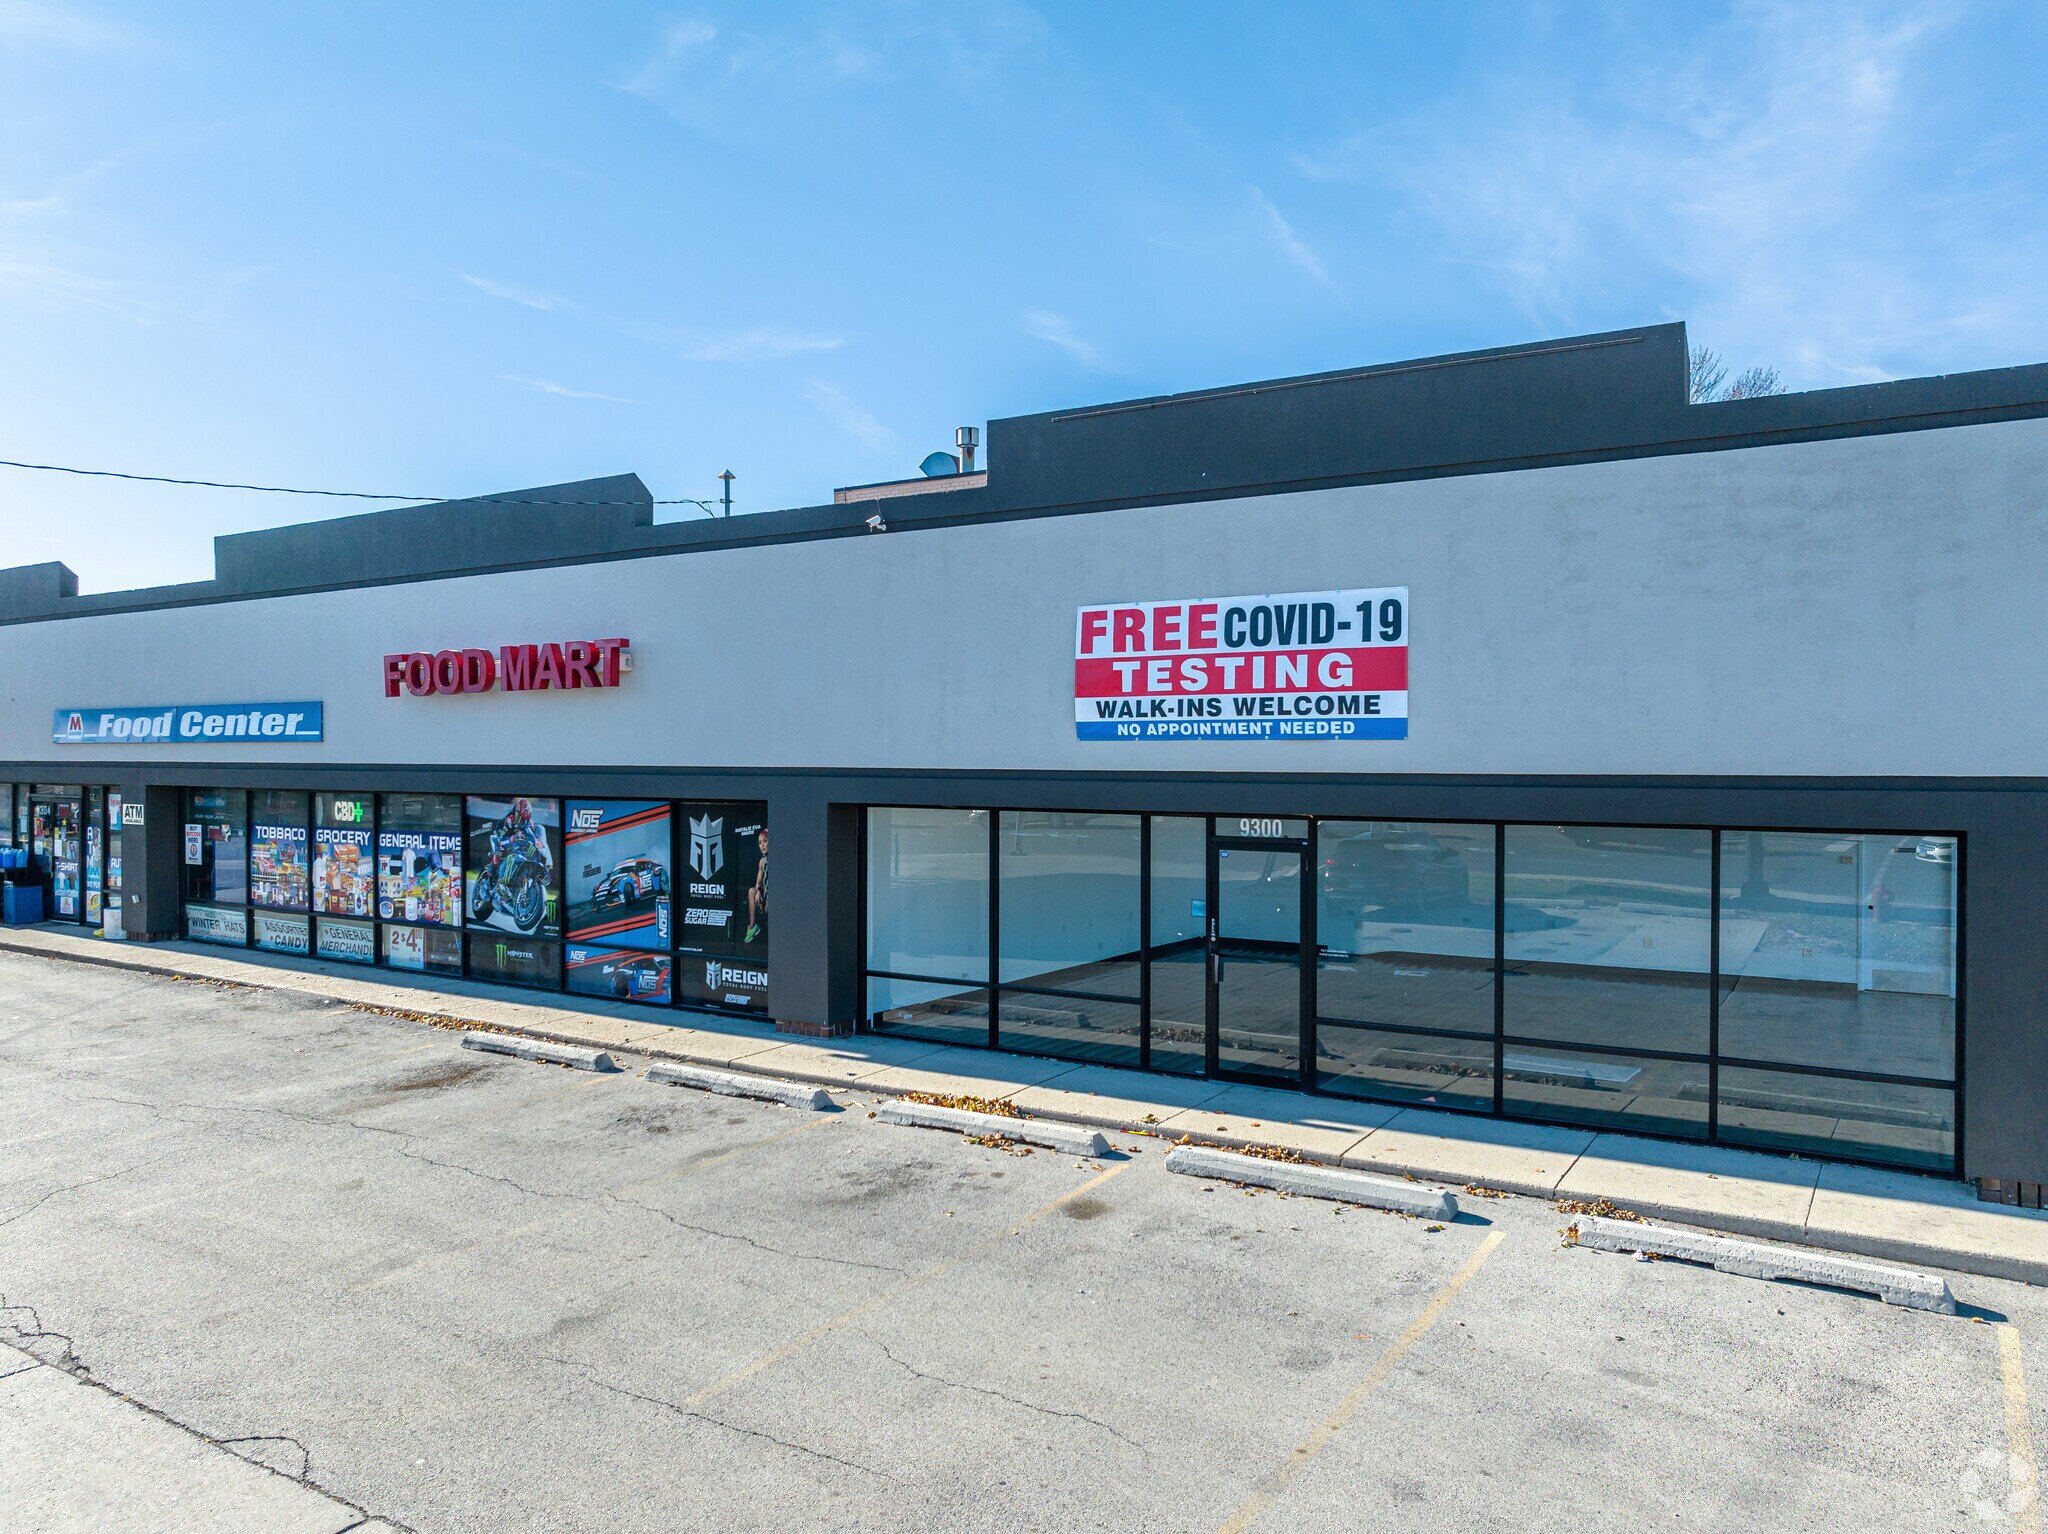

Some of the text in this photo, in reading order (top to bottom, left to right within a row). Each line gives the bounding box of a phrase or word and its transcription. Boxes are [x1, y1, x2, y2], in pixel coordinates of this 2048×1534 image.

[1080, 598, 1402, 654] FREE COVID-19
[383, 638, 630, 698] FOOD MART
[1112, 652, 1353, 692] TESTING
[1096, 694, 1381, 719] WALK-INS WELCOME
[99, 711, 305, 738] Food Center
[1117, 720, 1356, 736] NO APPOINTMENT NEEDED
[124, 805, 143, 818] ATM
[571, 809, 604, 828] NOS
[255, 826, 306, 841] TOBBACO
[1239, 818, 1283, 838] 9300
[316, 829, 371, 846] GROCERY
[379, 833, 462, 851] GENERAL ITEMS
[55, 862, 78, 872] T-SHIRT
[690, 883, 725, 895] REIGN
[658, 904, 668, 938] NOS
[684, 916, 708, 925] SUGAR
[686, 908, 709, 918] ZERO
[190, 917, 245, 934] WINTER HATS
[274, 935, 308, 949] CANDY
[330, 928, 373, 943] GENERAL
[570, 950, 587, 961] NOS
[638, 975, 659, 990] NOS
[722, 968, 768, 986] REIGN
